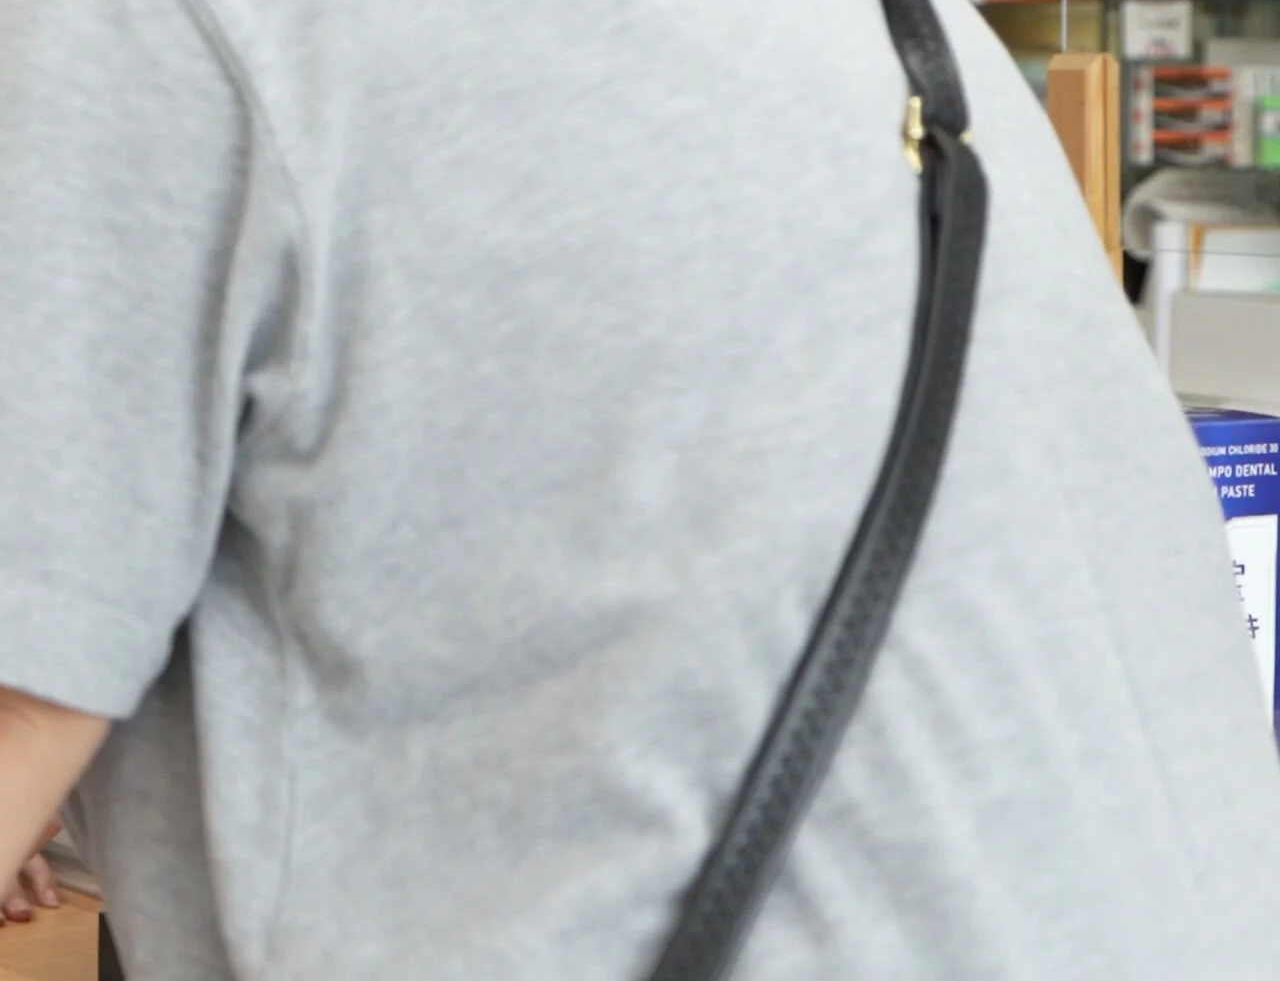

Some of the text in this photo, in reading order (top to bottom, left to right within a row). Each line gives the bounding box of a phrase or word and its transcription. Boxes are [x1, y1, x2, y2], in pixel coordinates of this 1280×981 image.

[1200, 446, 1227, 457] ODIUM
[1209, 463, 1278, 479] MPO DENTAL
[1221, 483, 1256, 498] PASTE
